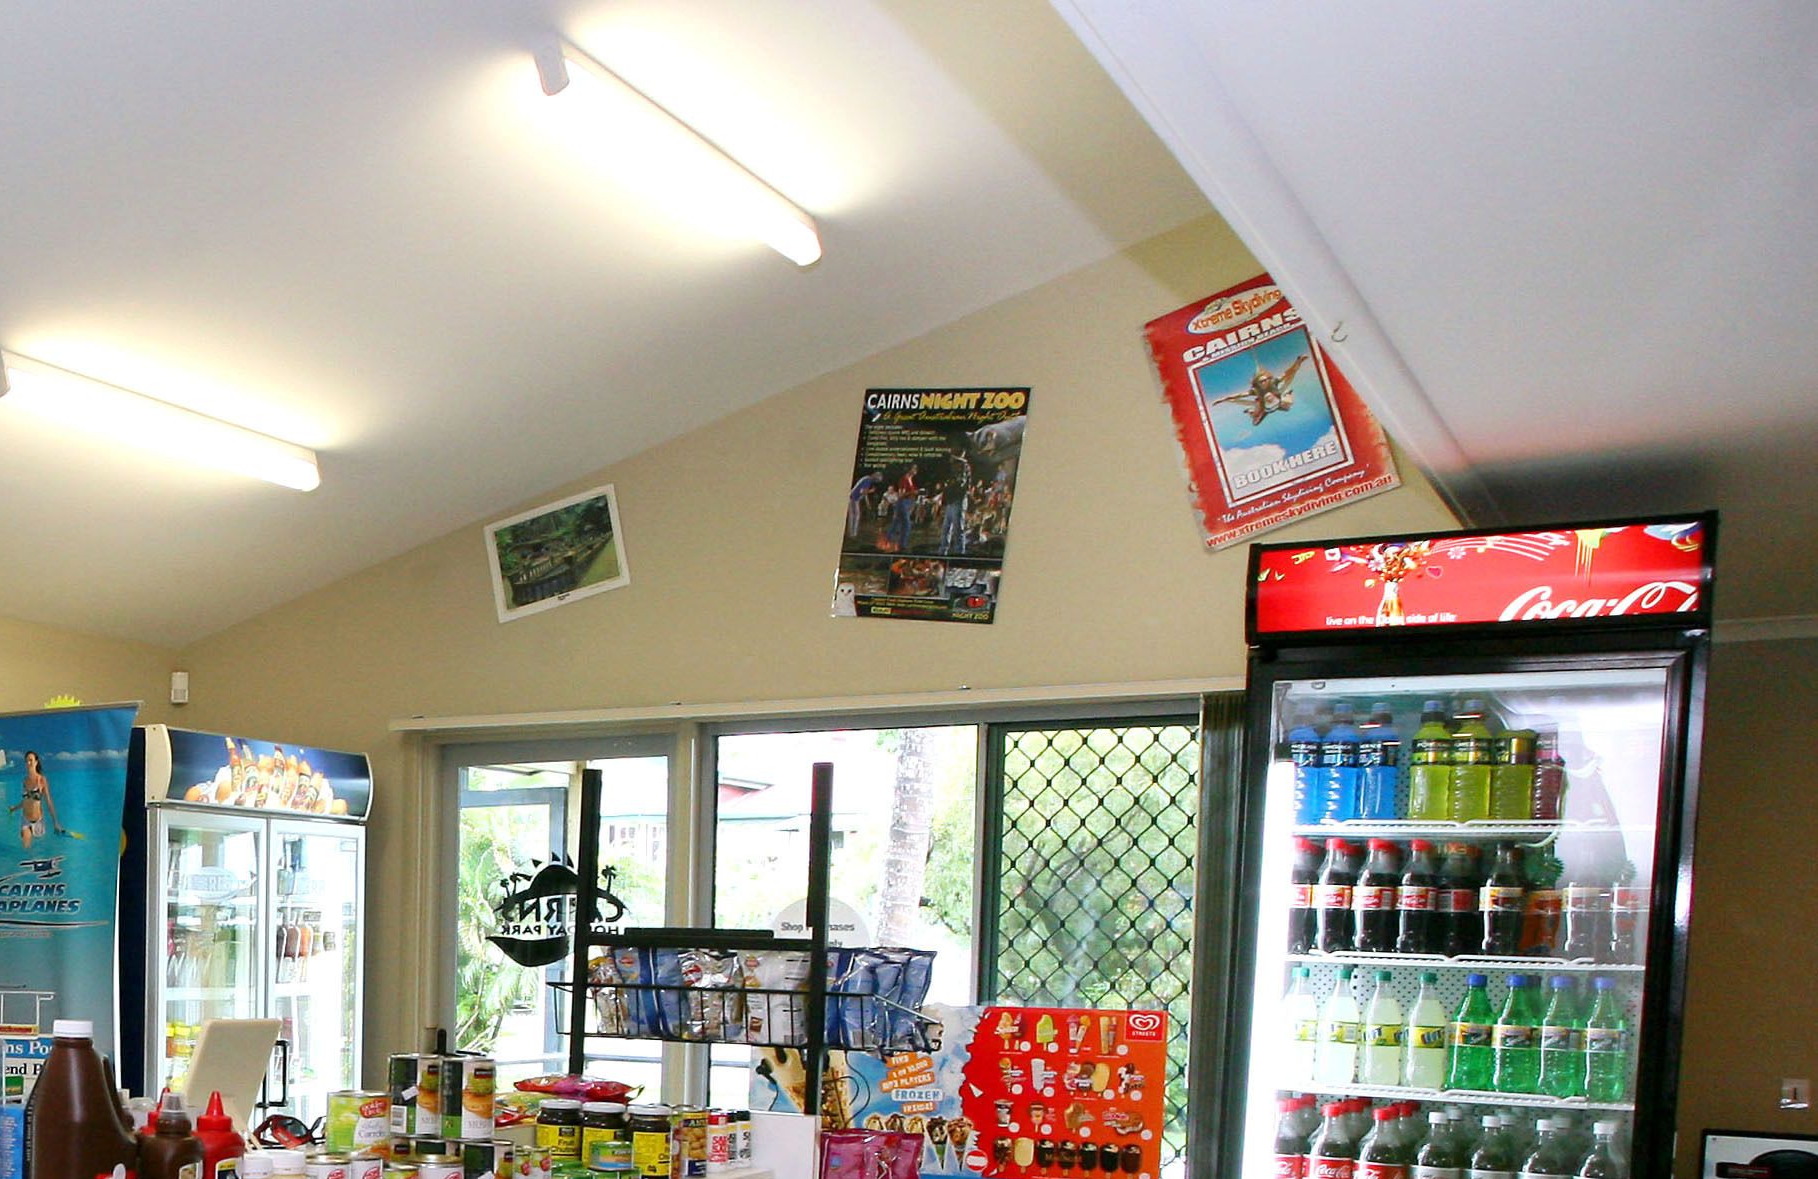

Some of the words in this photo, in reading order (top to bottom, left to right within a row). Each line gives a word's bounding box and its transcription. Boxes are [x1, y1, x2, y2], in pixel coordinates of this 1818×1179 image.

[1193, 306, 1232, 331] Xtreme
[1232, 289, 1282, 316] Skydiving
[1183, 307, 1299, 362] CAIRNS
[867, 393, 920, 409] CAIRNS
[919, 393, 981, 409] NIGHT
[982, 392, 1026, 409] ZOO
[1234, 459, 1288, 489] BOOK
[1288, 441, 1337, 470] HERE
[1206, 474, 1394, 547] www.xtremeskydiving.com.au
[1344, 617, 1357, 625] on
[1358, 615, 1375, 625] the
[1406, 614, 1426, 623] side
[1428, 613, 1439, 623] of
[781, 922, 804, 934] Shop
[895, 1090, 940, 1100] FROZEN
